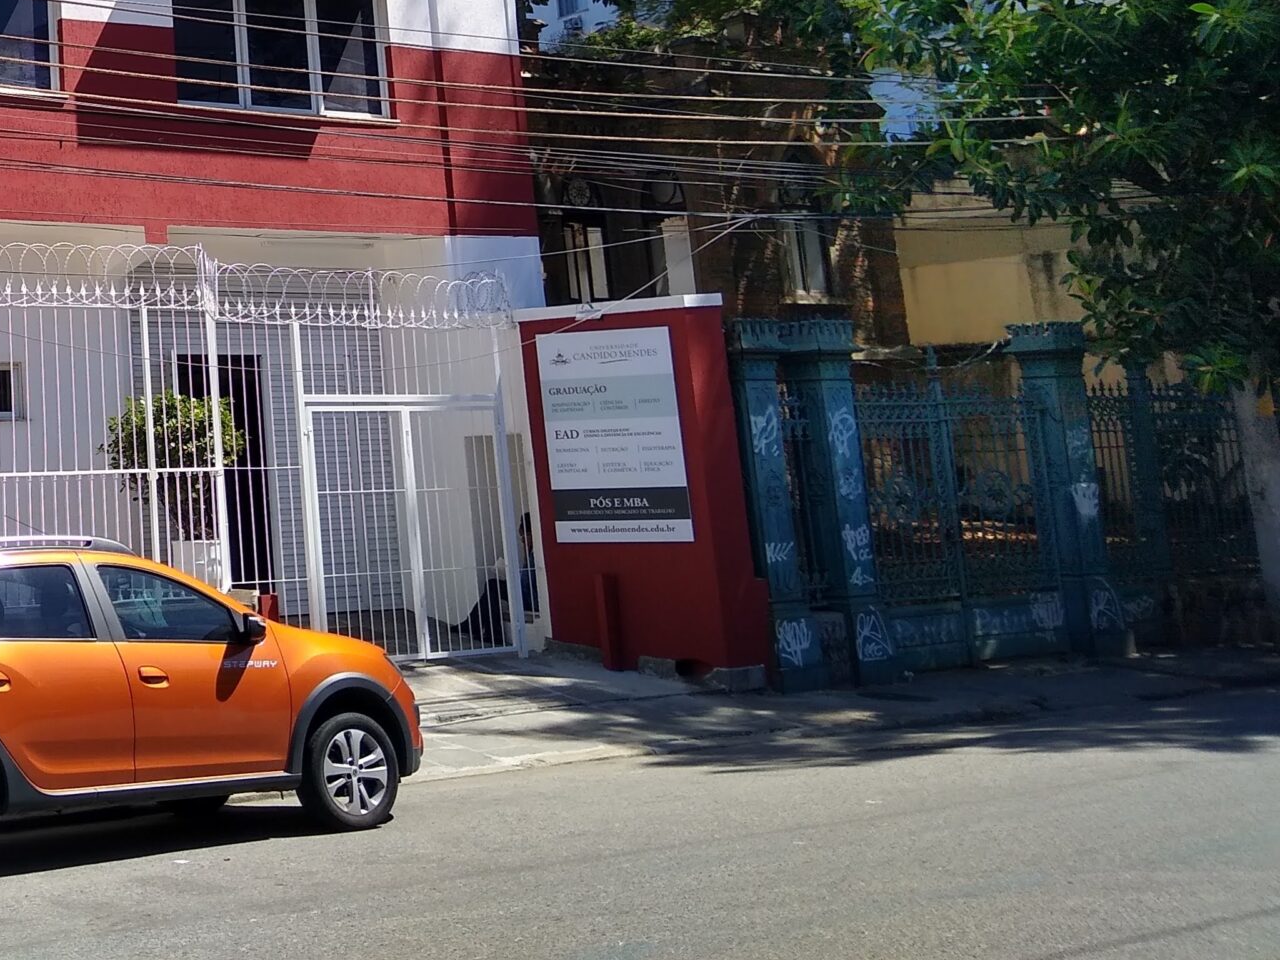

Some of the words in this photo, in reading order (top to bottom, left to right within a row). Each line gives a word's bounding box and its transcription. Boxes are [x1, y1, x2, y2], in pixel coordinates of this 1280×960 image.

[572, 350, 618, 361] CANDIDO
[619, 347, 658, 358] MENDES
[548, 384, 607, 396] GRADUAÇÃO
[554, 429, 579, 440] EAD
[590, 496, 612, 508] PÓS
[614, 498, 622, 508] E
[623, 497, 649, 507] MBA
[570, 524, 676, 533] www.candidomendes.edu.br
[223, 660, 278, 668] STEPWAY
